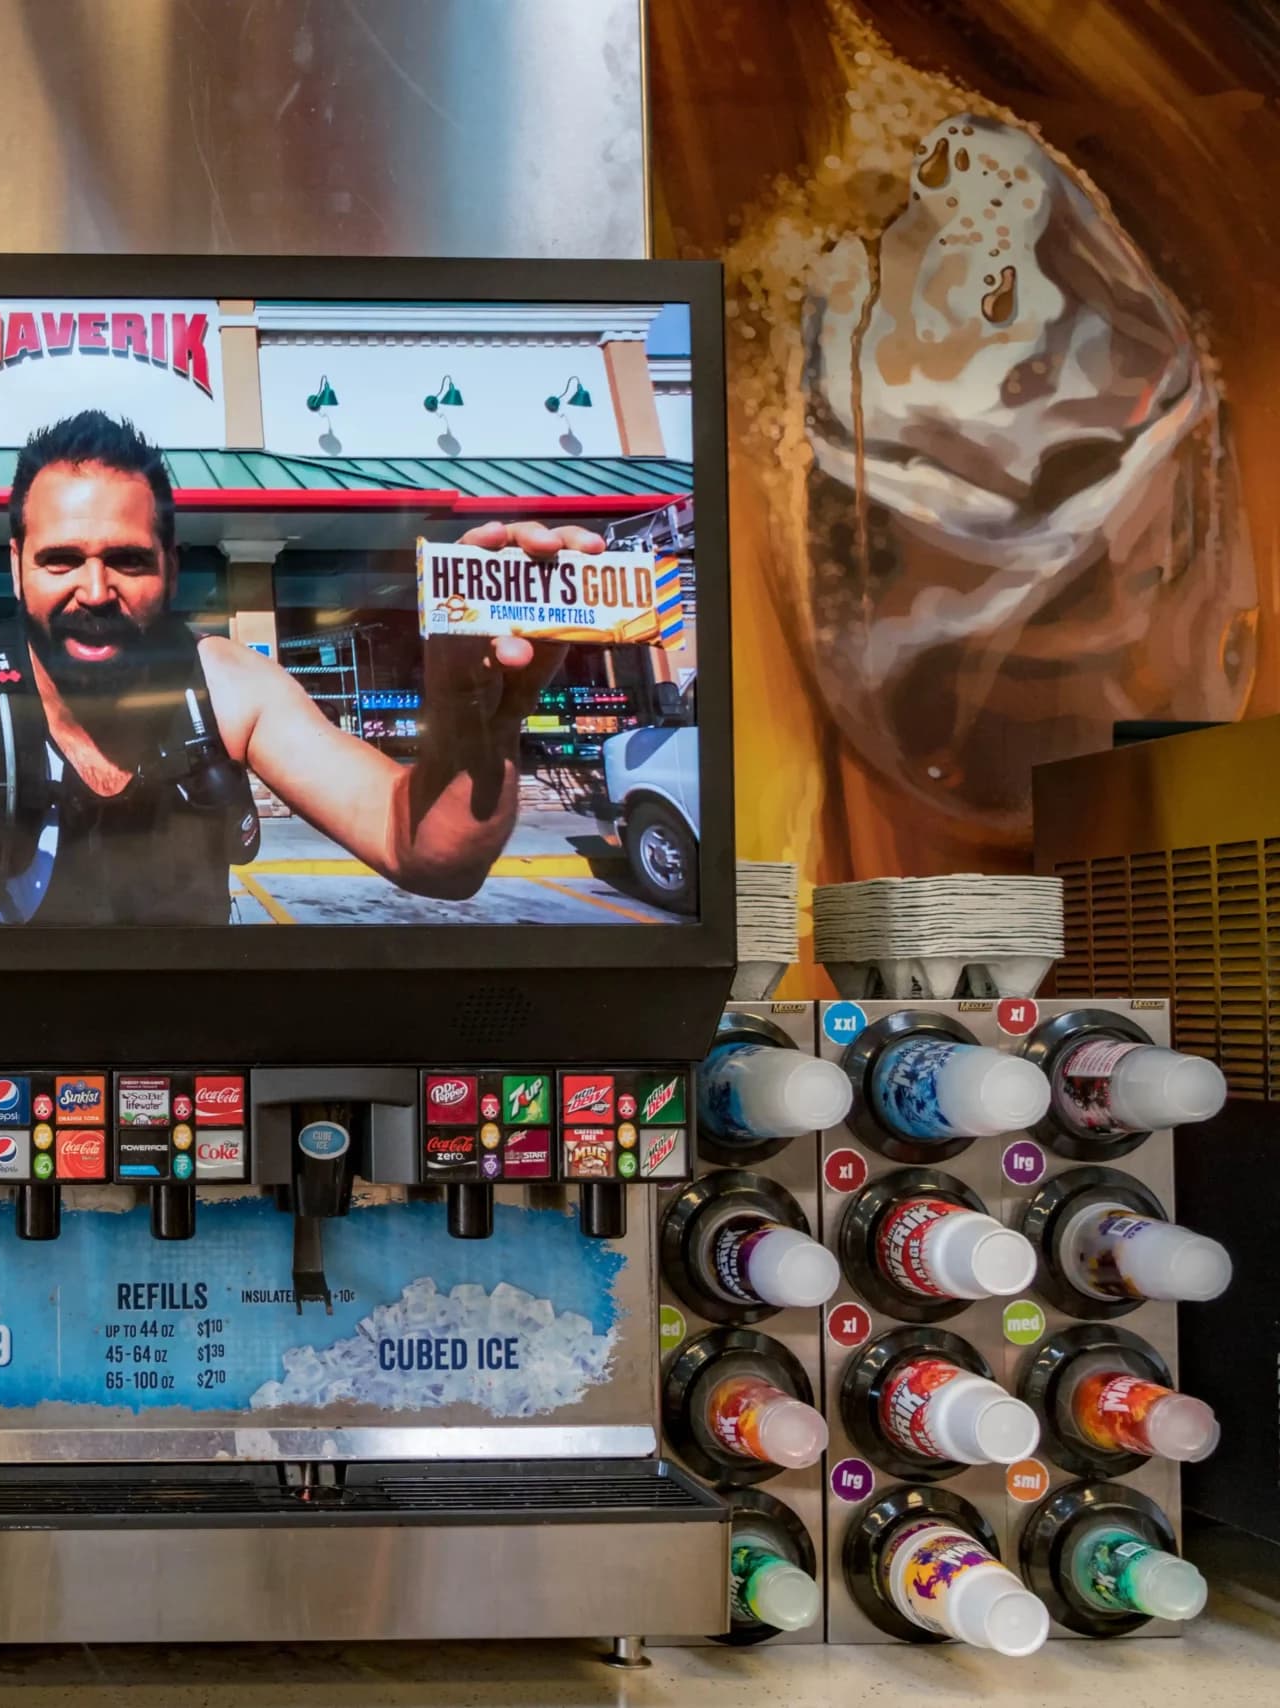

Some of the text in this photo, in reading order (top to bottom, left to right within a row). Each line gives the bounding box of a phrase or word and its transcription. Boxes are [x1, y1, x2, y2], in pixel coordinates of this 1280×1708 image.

[432, 556, 653, 608] HERSHEY'S GOLD
[490, 605, 595, 624] PEANUTS & PRETZELS
[1010, 1008, 1024, 1022] xl
[834, 1016, 857, 1032] xxl
[60, 1090, 99, 1105] Sunkist
[198, 1144, 239, 1159] Coke
[574, 1146, 607, 1161] MUG
[1013, 1153, 1034, 1171] lrg
[839, 1163, 853, 1179] xl
[117, 1282, 208, 1310] REFILLS
[106, 1324, 120, 1338] UP
[124, 1324, 137, 1338] TO
[140, 1320, 158, 1338] 44
[660, 1319, 680, 1336] ed
[843, 1318, 857, 1334] xl
[1007, 1314, 1040, 1332] med
[379, 1337, 520, 1371] CUBED ICE
[842, 1470, 864, 1490] lrg
[1013, 1473, 1040, 1490] sml
